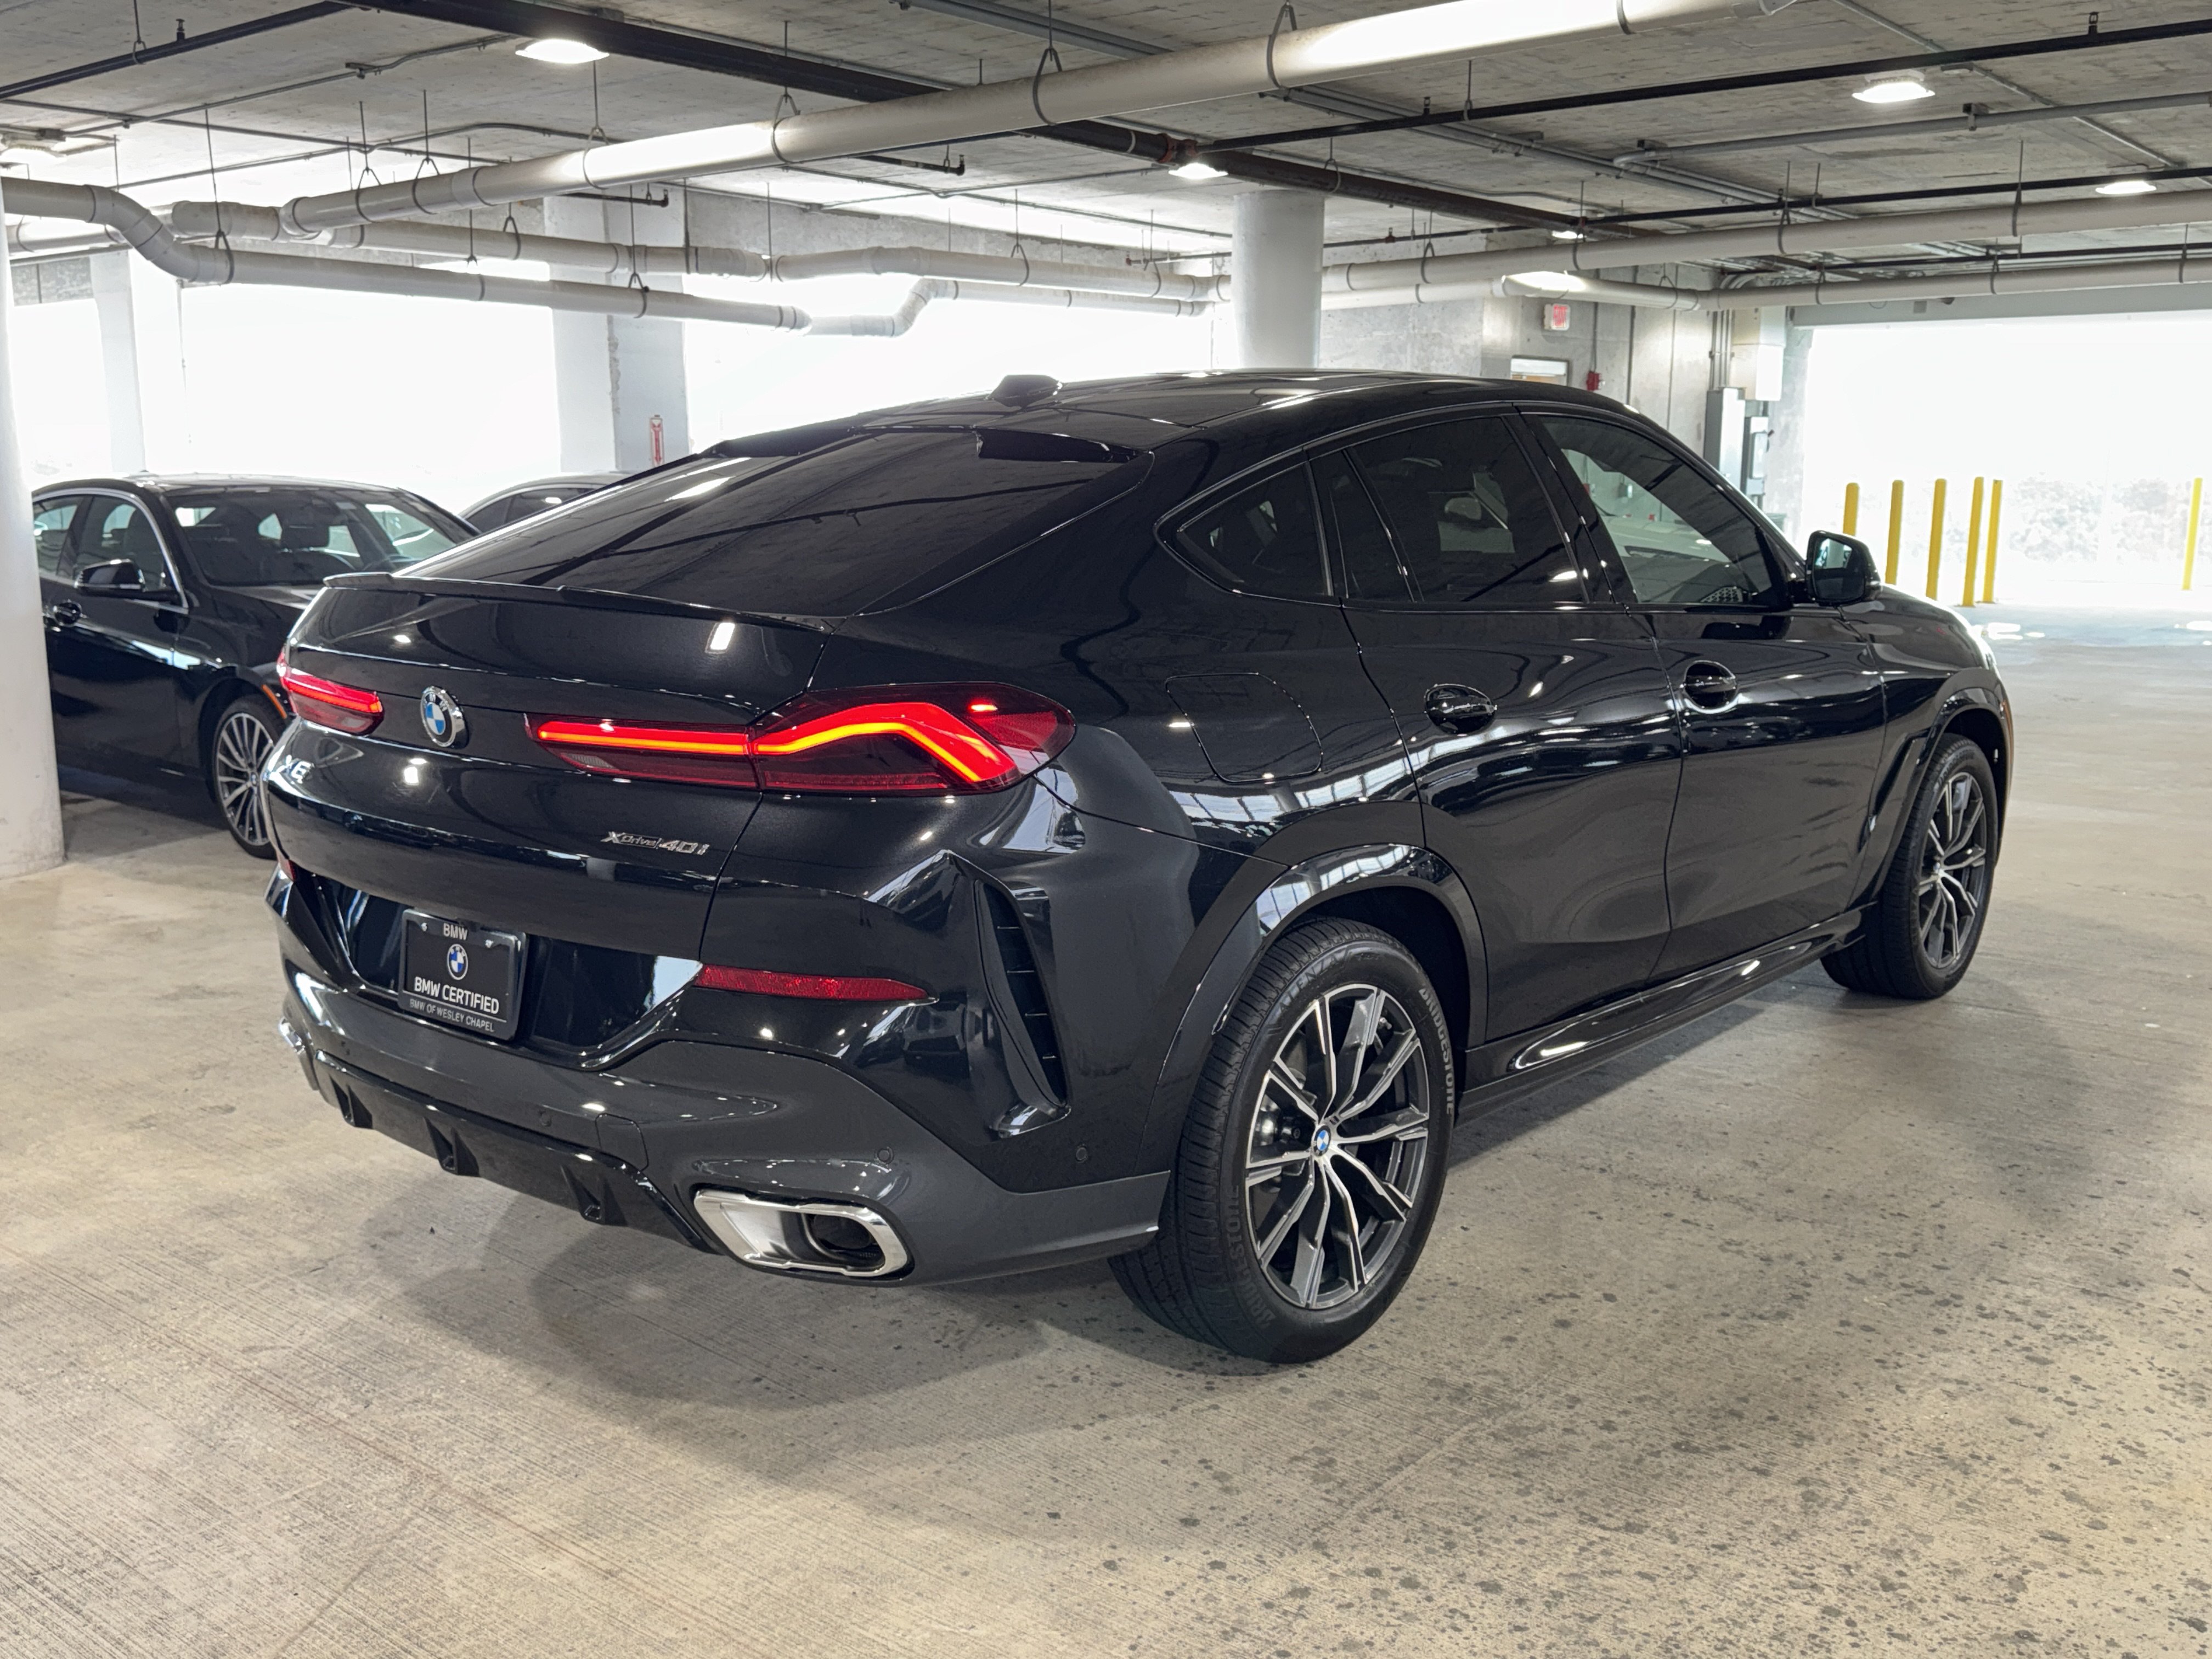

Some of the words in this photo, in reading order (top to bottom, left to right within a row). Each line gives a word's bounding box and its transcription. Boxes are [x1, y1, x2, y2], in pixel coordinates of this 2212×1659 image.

[443, 923, 467, 940] BMW
[415, 977, 441, 997] BMW
[442, 985, 499, 1014] CERTIFIED
[410, 998, 425, 1011] BMW
[426, 1003, 436, 1014] OF
[437, 1007, 465, 1023] WESLEY
[466, 1015, 495, 1032] CHAPEL
[1419, 988, 1454, 1115] BRIDGESTONE
